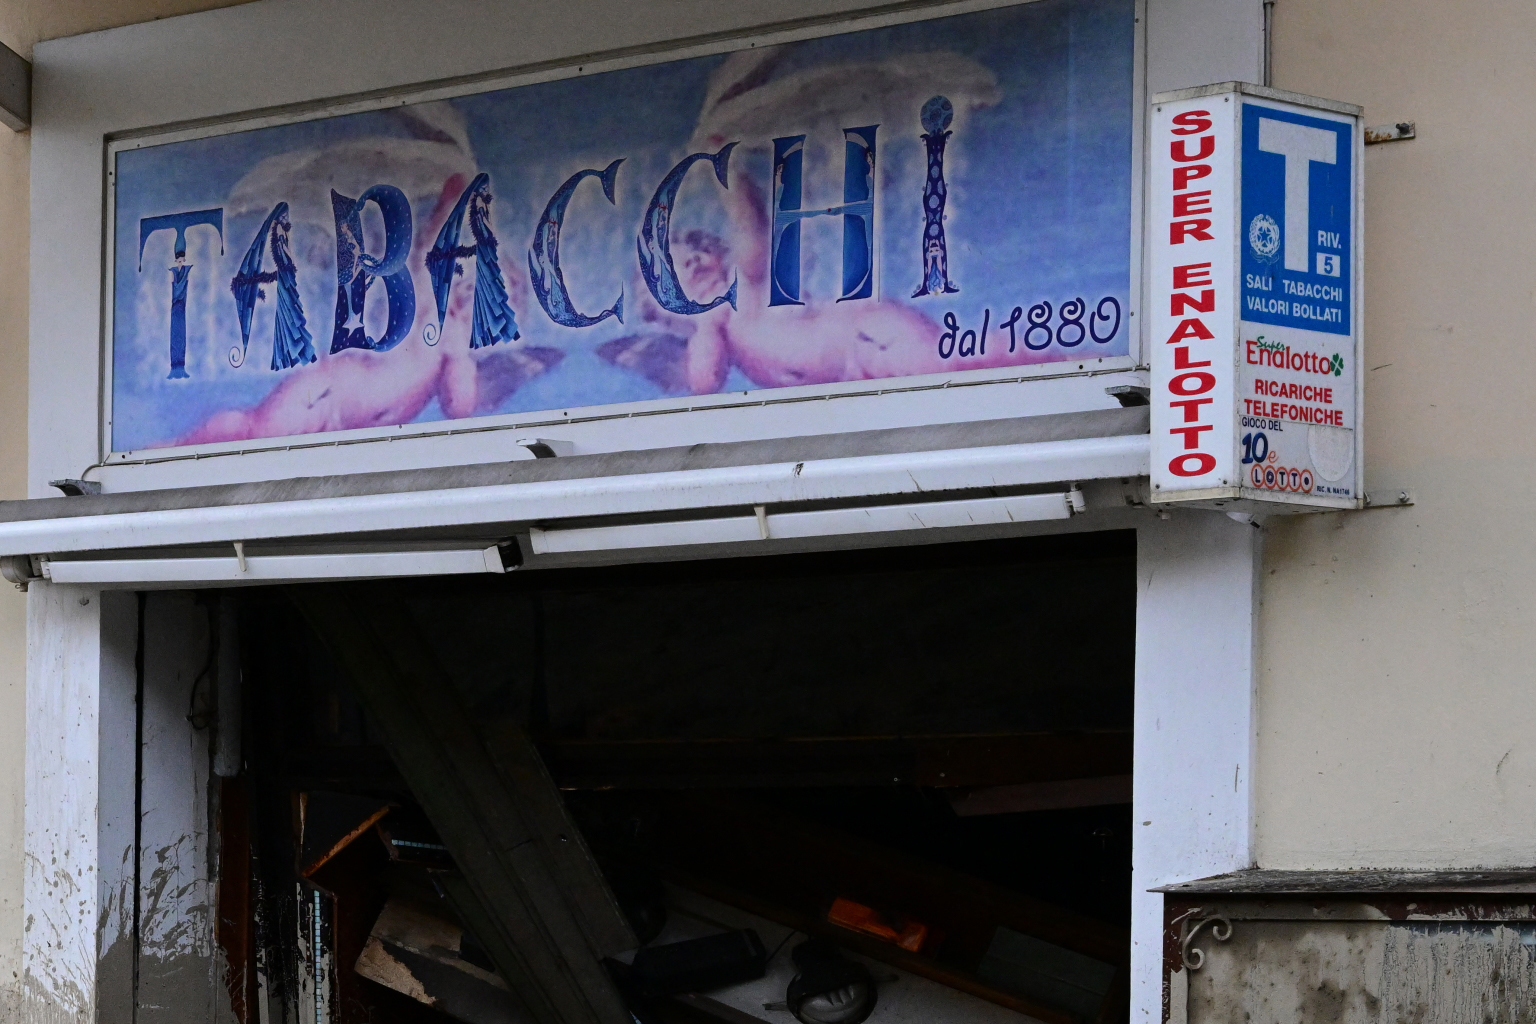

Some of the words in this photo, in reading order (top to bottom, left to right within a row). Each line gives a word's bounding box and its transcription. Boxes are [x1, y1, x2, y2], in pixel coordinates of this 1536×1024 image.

[1169, 110, 1216, 246] SUPER
[1258, 117, 1337, 273] T
[138, 95, 960, 381] TABACCHI
[1317, 230, 1342, 249] RIV.
[1324, 256, 1334, 275] 5
[1246, 274, 1272, 291] SALI
[1283, 279, 1342, 302] TABACCHI
[1247, 295, 1289, 316] VALORI
[1293, 302, 1342, 323] BOLLATI
[938, 308, 990, 360] dal
[1000, 296, 1121, 353] 1880
[1246, 340, 1331, 375] Enalotto
[1256, 336, 1285, 355] Super
[1166, 262, 1217, 478] ENALOTTO
[1255, 379, 1333, 404] RICARICHE
[1242, 417, 1266, 430] GIOCO
[1268, 420, 1284, 432] DEL
[1244, 399, 1344, 426] TELEFONICHE
